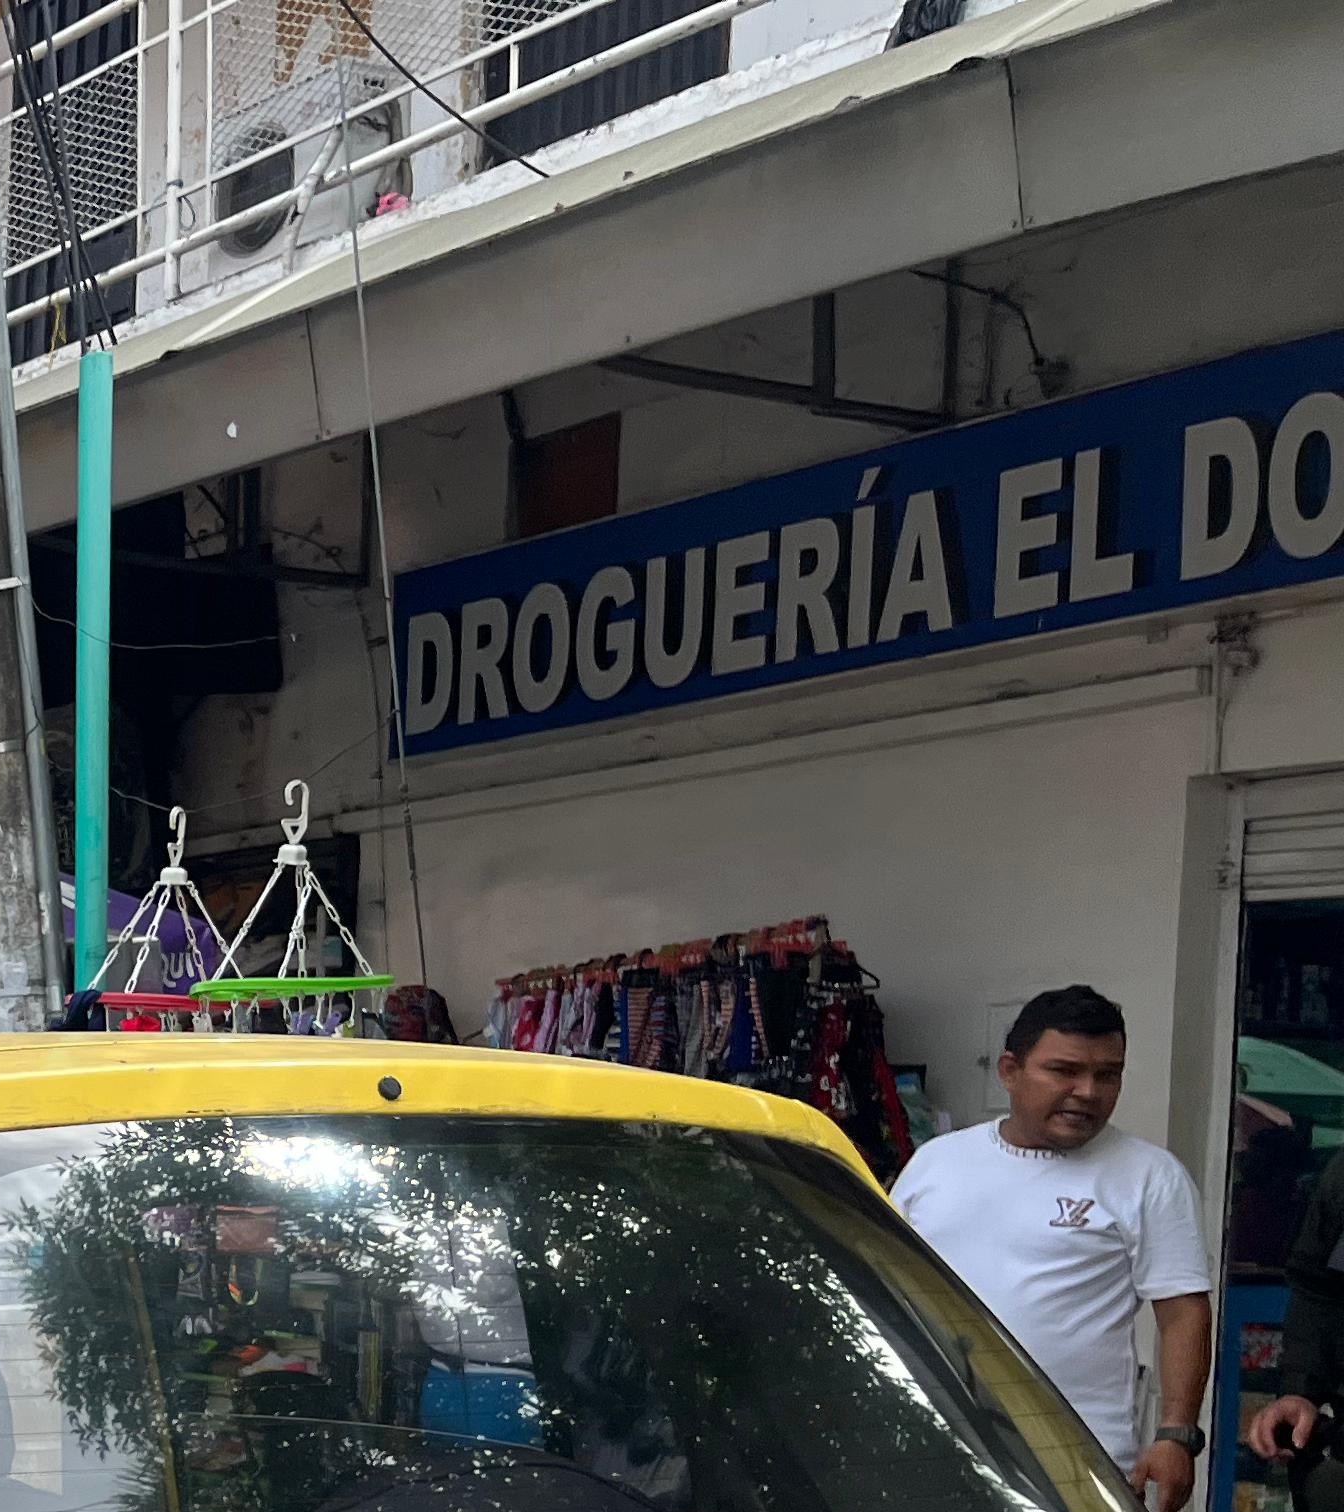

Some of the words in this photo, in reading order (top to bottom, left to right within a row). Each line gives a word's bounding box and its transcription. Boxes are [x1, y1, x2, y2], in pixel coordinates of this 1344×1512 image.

[405, 465, 954, 737] DROGUERÍA
[994, 447, 1134, 619] EL
[1180, 391, 1344, 581] DO
